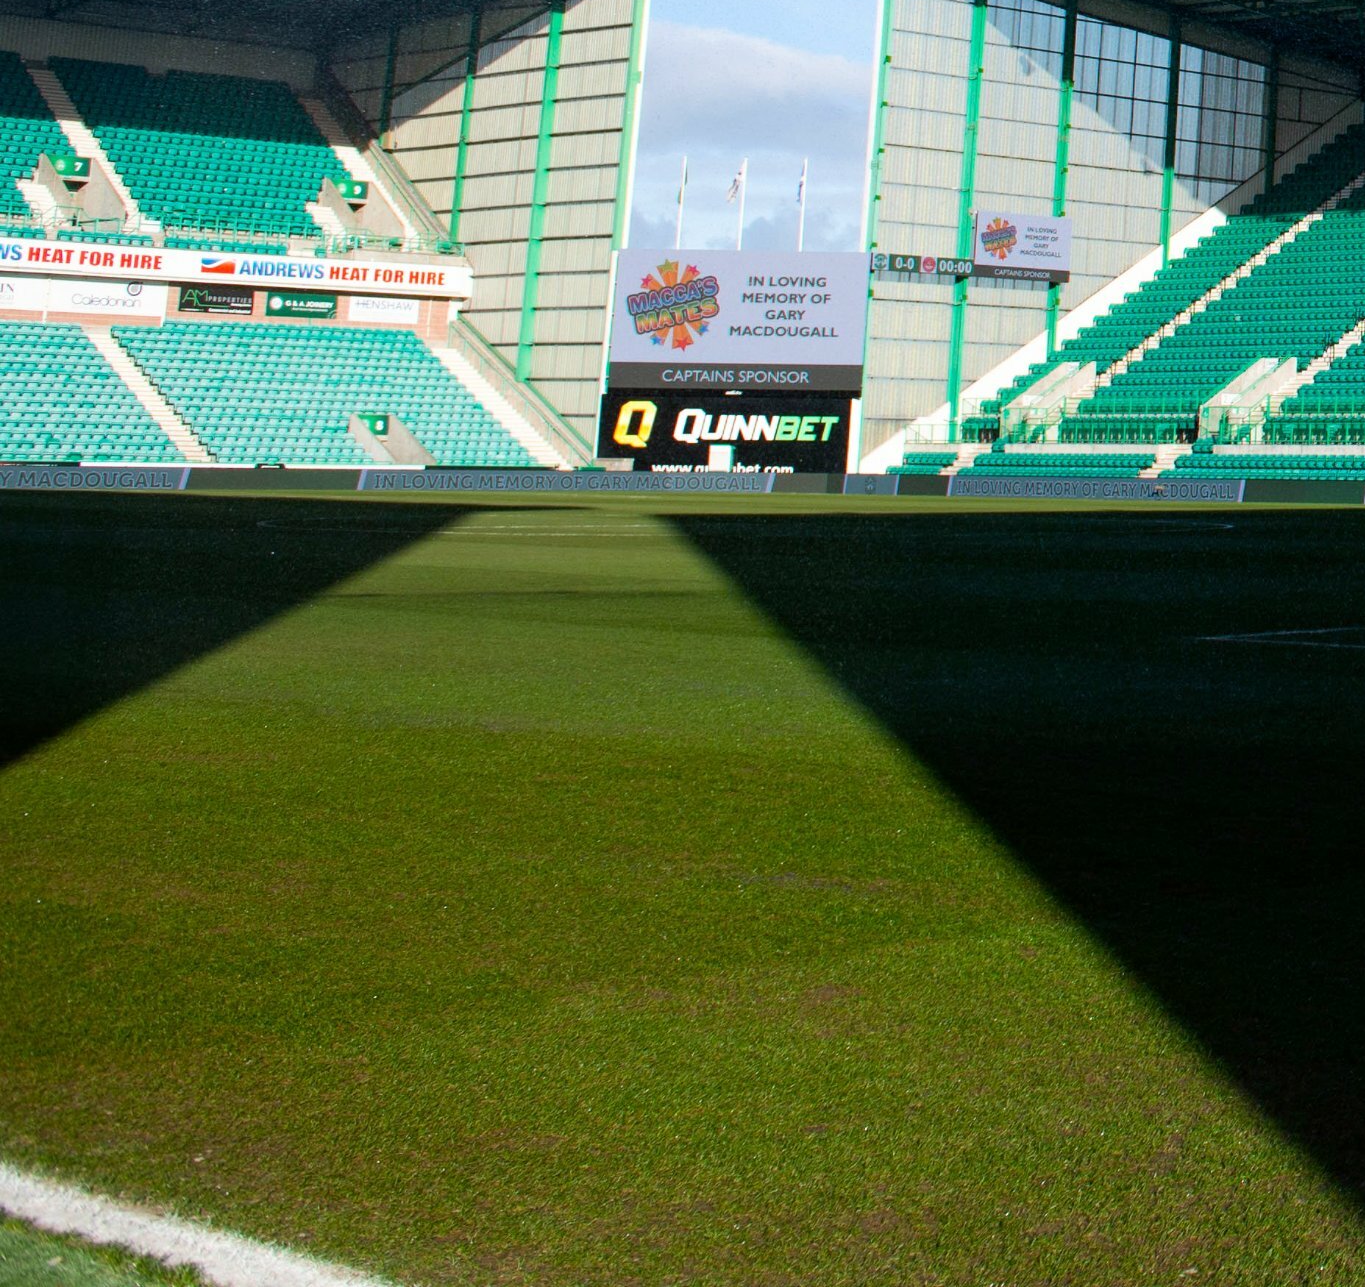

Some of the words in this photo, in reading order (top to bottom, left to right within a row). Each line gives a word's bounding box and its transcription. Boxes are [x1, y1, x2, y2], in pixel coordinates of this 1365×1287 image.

[74, 161, 83, 172] 7
[353, 185, 362, 195] 9
[27, 247, 75, 264] HEAT
[79, 250, 115, 267] FOR
[119, 253, 163, 270] HIRE
[895, 257, 916, 270] 0-0
[239, 260, 325, 280] ANDREWS
[329, 266, 370, 282] HEAT
[373, 268, 404, 283] FOR
[408, 270, 446, 286] HIRE
[940, 260, 972, 274] 00:00
[994, 268, 1022, 277] CAPTAINS
[1023, 270, 1051, 280] SPONSOR
[748, 276, 765, 288] IN
[769, 277, 828, 288] LOVING
[71, 293, 141, 308] Caledonian
[627, 275, 720, 316] MACCA'S
[742, 293, 807, 304] MEMORY
[810, 294, 832, 305] OF
[355, 299, 414, 311] HENSHAW
[634, 296, 720, 335] MATES
[765, 309, 806, 320] GARY
[729, 326, 839, 338] MACDOUGALL
[662, 369, 734, 384] CAPTAINS
[738, 369, 810, 384] SPONSOR
[375, 420, 384, 431] 8
[613, 400, 658, 448] Q
[673, 408, 840, 444] QUINNBET
[17, 470, 174, 488] MACDOUGALL
[374, 474, 396, 490] IN
[399, 474, 474, 490] LOVING
[478, 474, 556, 490] MEMORY
[560, 474, 582, 490] OF
[587, 475, 631, 491] GARY
[635, 475, 761, 491] MACDOUGALL
[957, 480, 971, 495] IN
[972, 480, 1021, 496] LOVING
[1025, 481, 1079, 497] MEMORY
[1082, 482, 1101, 498] OF
[1102, 482, 1138, 498] GARY
[1140, 483, 1234, 500] MACDOUGALL
